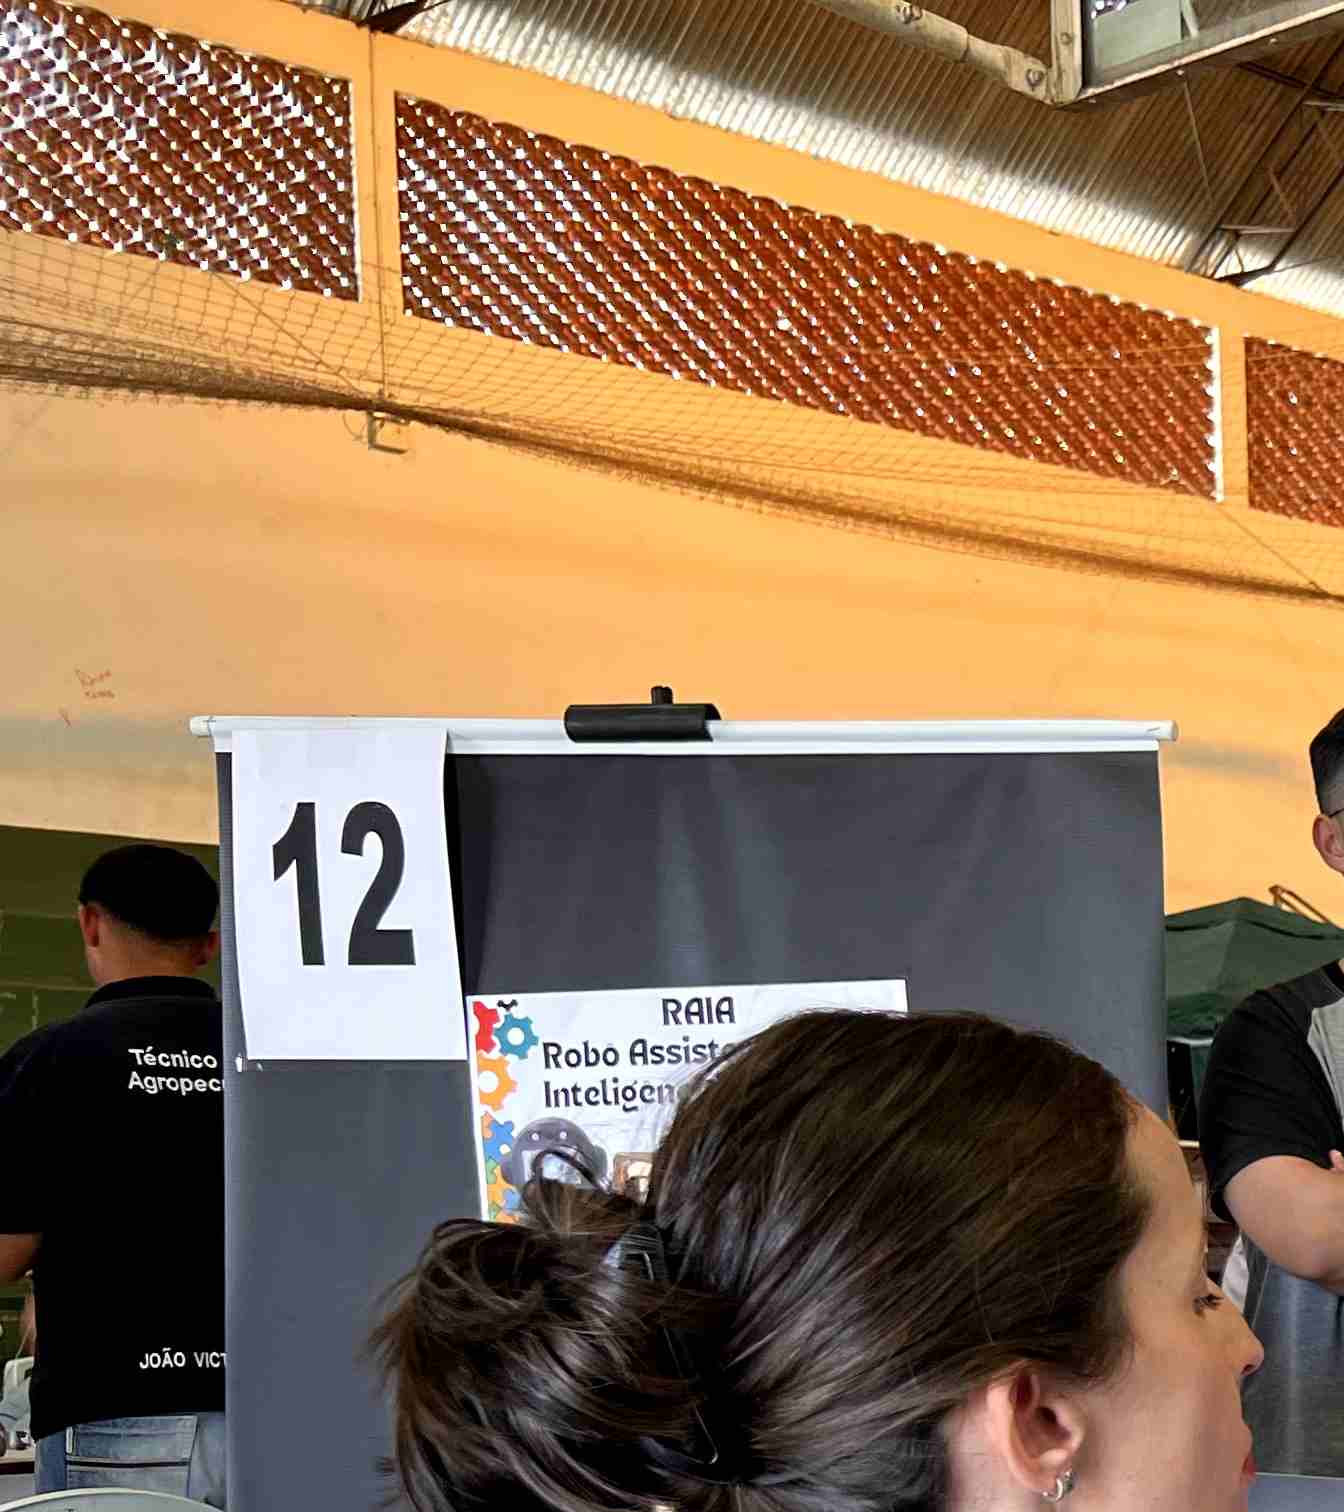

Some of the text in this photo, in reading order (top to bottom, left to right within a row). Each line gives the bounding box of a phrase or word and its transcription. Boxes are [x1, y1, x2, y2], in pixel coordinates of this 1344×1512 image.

[271, 800, 417, 967] 12
[661, 996, 737, 1026] RAIA
[127, 1045, 218, 1069] Técnico
[127, 1071, 226, 1097] Agropec
[139, 1347, 186, 1369] JOÃO
